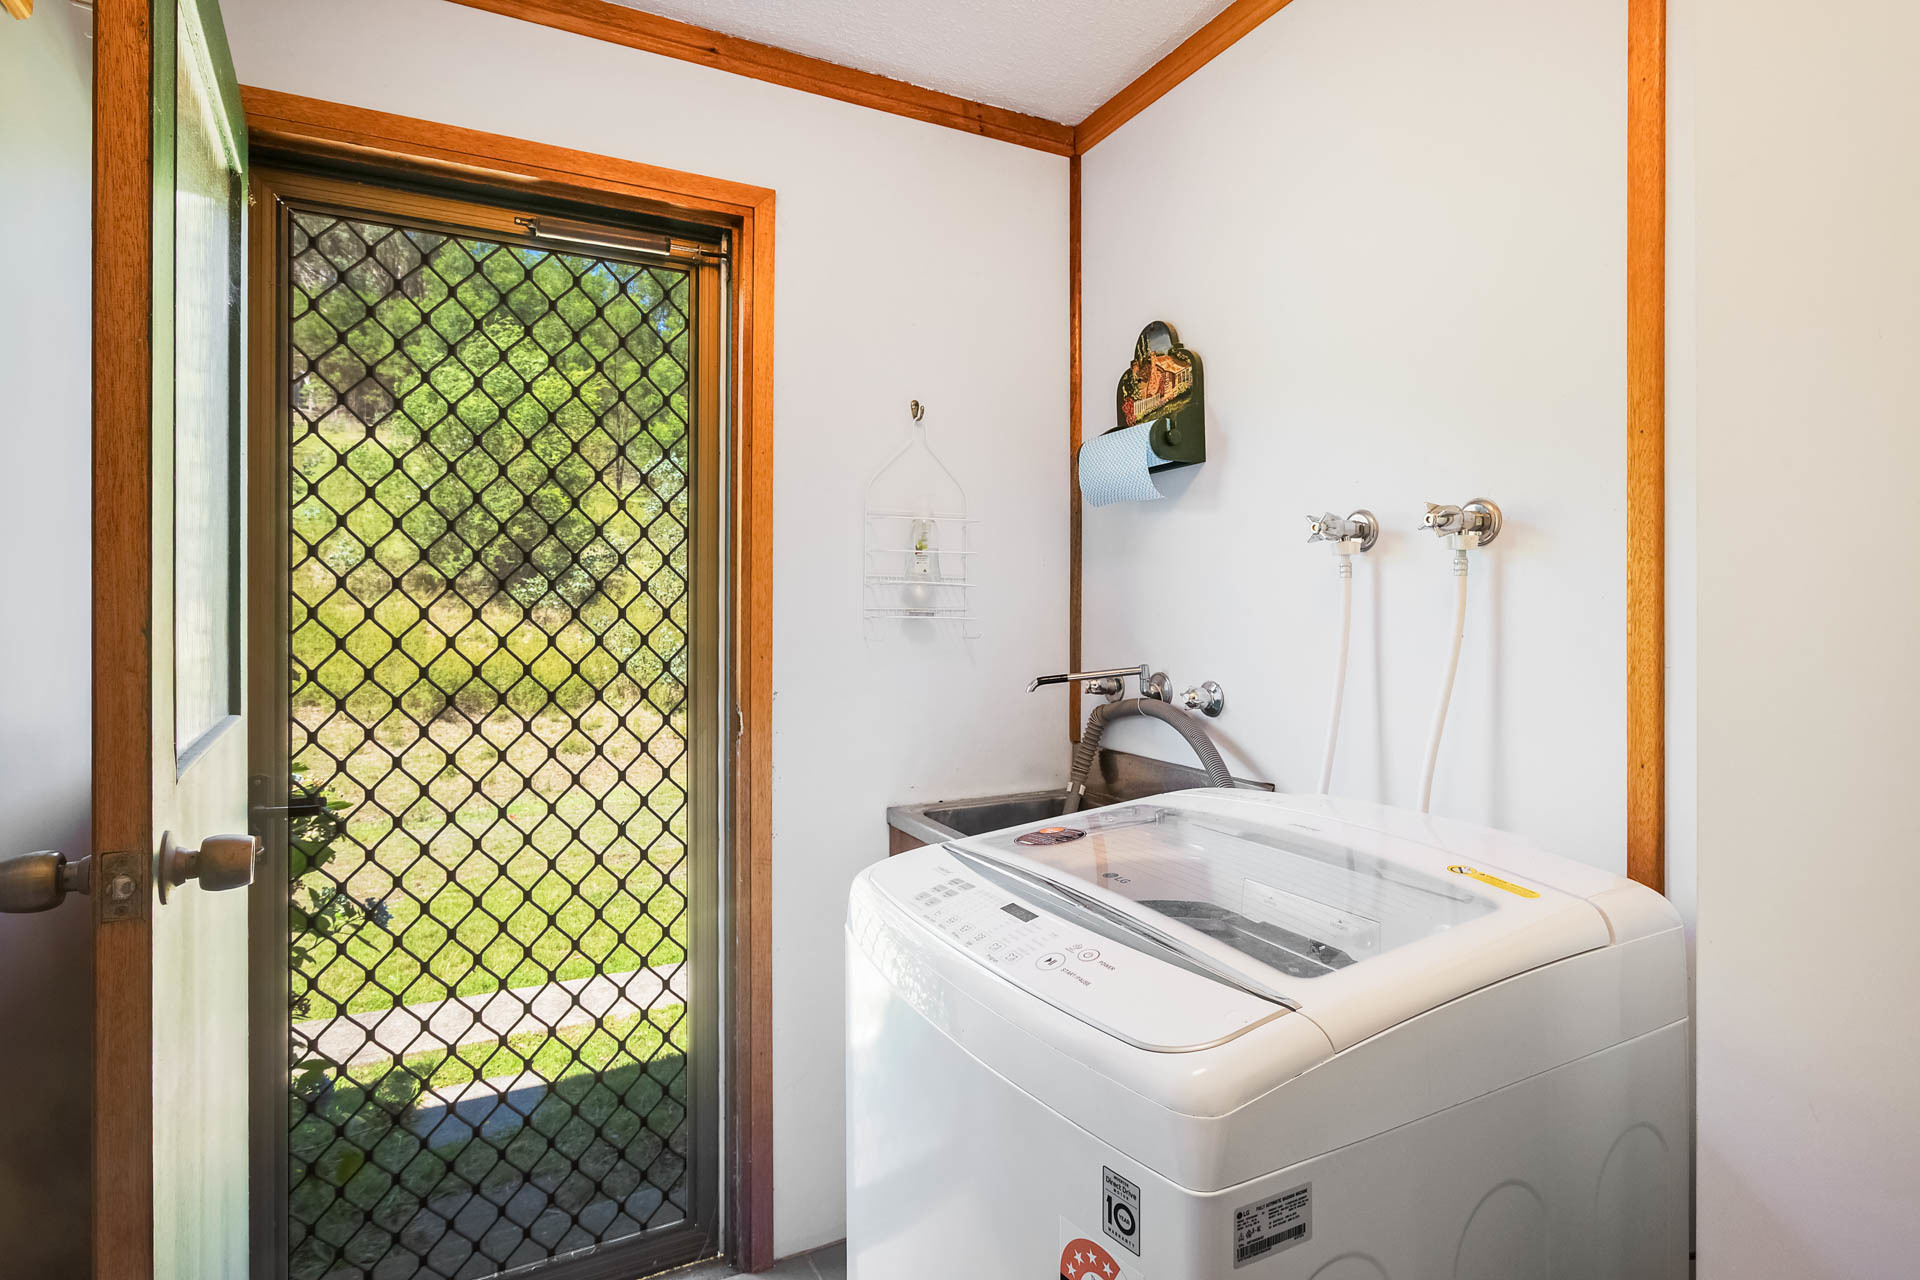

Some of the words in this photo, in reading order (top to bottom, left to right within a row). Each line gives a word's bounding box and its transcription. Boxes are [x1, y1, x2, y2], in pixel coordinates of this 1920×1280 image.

[1114, 876, 1131, 884] LG
[1105, 1175, 1121, 1191] Direct
[1122, 1186, 1137, 1200] Drive
[1106, 1194, 1136, 1236] 10
[1118, 1213, 1130, 1226] YEAR
[1107, 1227, 1135, 1248] WARRANTY
